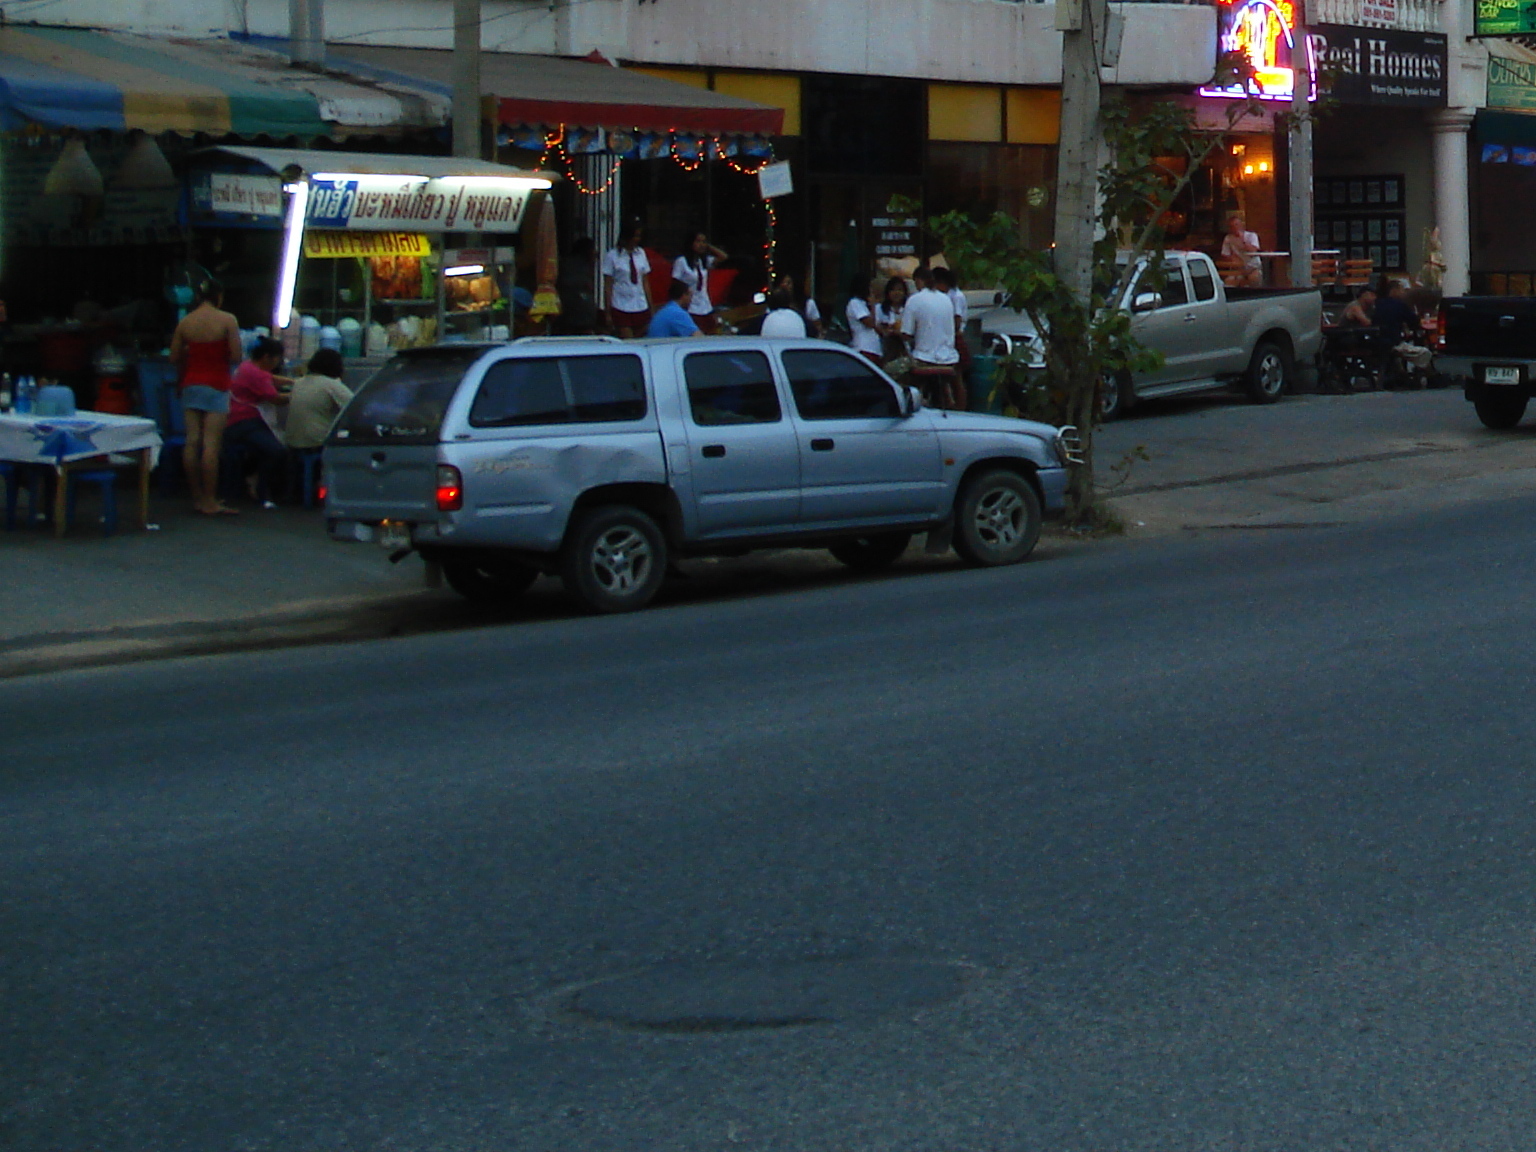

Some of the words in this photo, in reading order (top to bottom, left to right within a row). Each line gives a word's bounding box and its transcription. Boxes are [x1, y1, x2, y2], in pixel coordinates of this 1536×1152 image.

[1313, 34, 1361, 75] Real
[1367, 38, 1441, 79] Homes
[464, 196, 523, 228] หมูแดง
